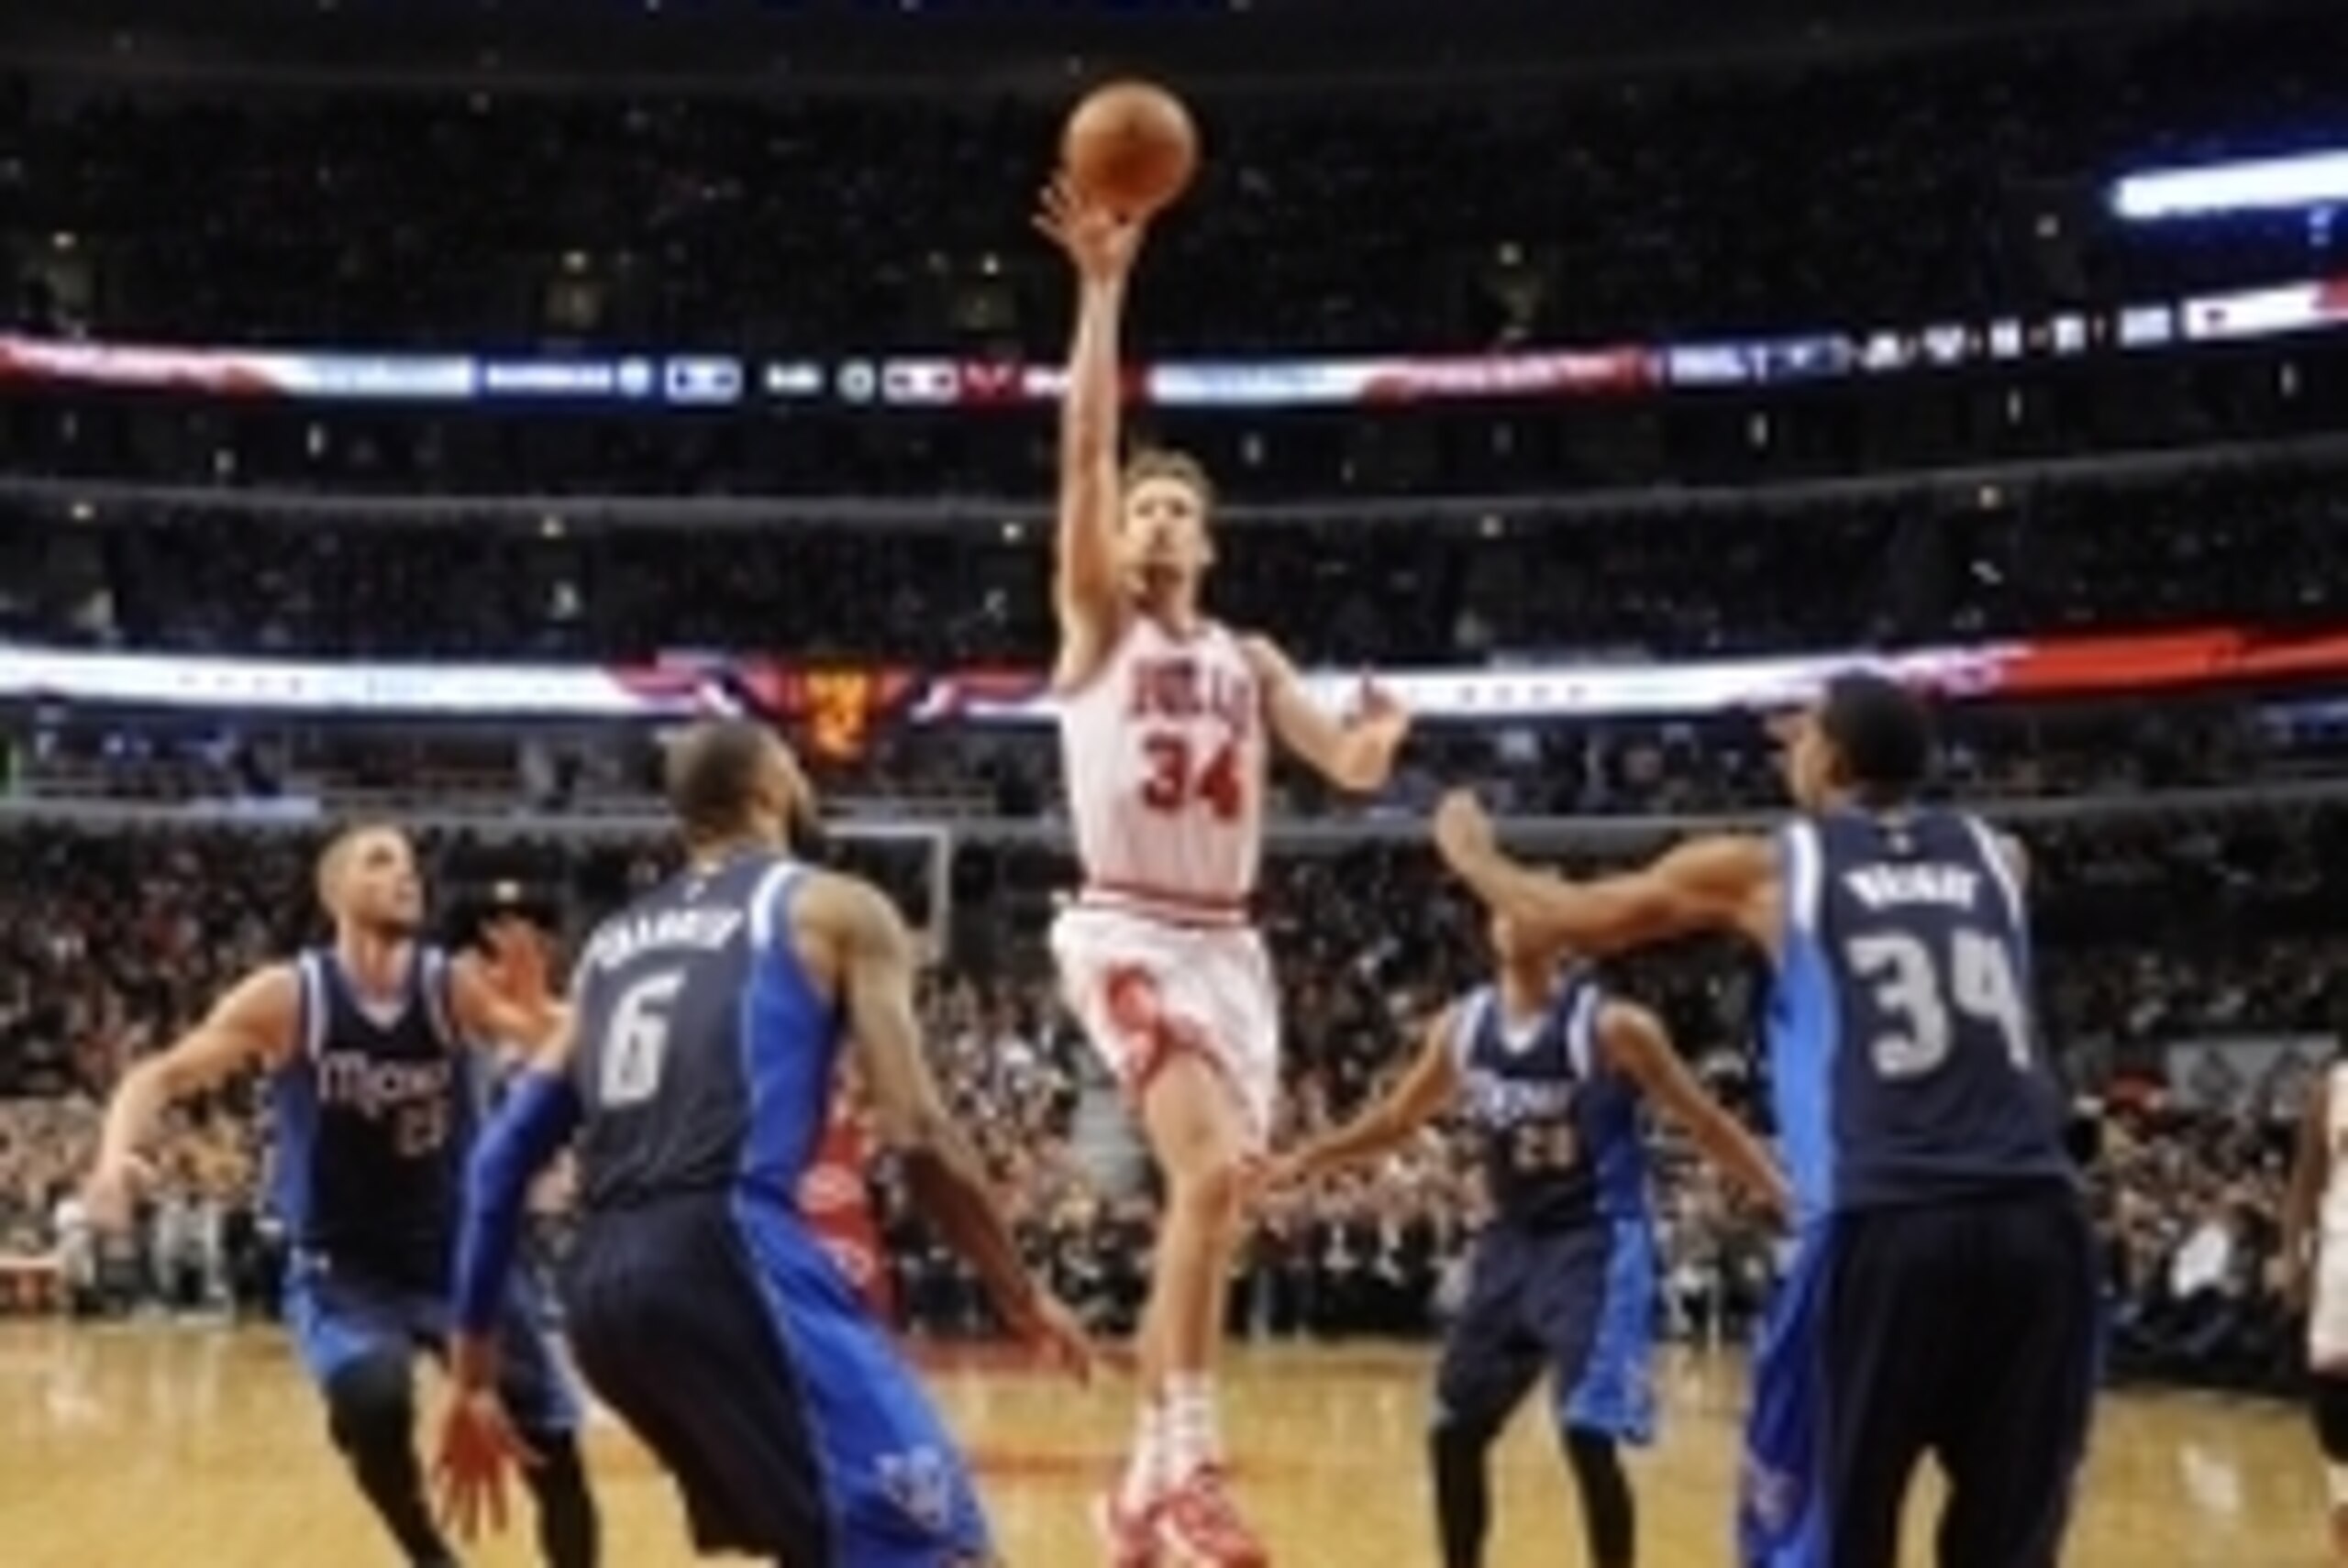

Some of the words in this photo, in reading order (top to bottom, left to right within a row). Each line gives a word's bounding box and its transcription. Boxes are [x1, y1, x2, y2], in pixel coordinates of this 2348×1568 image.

[1143, 735, 1243, 822] 34
[600, 967, 685, 1105] 6
[1845, 929, 2032, 1076] 34
